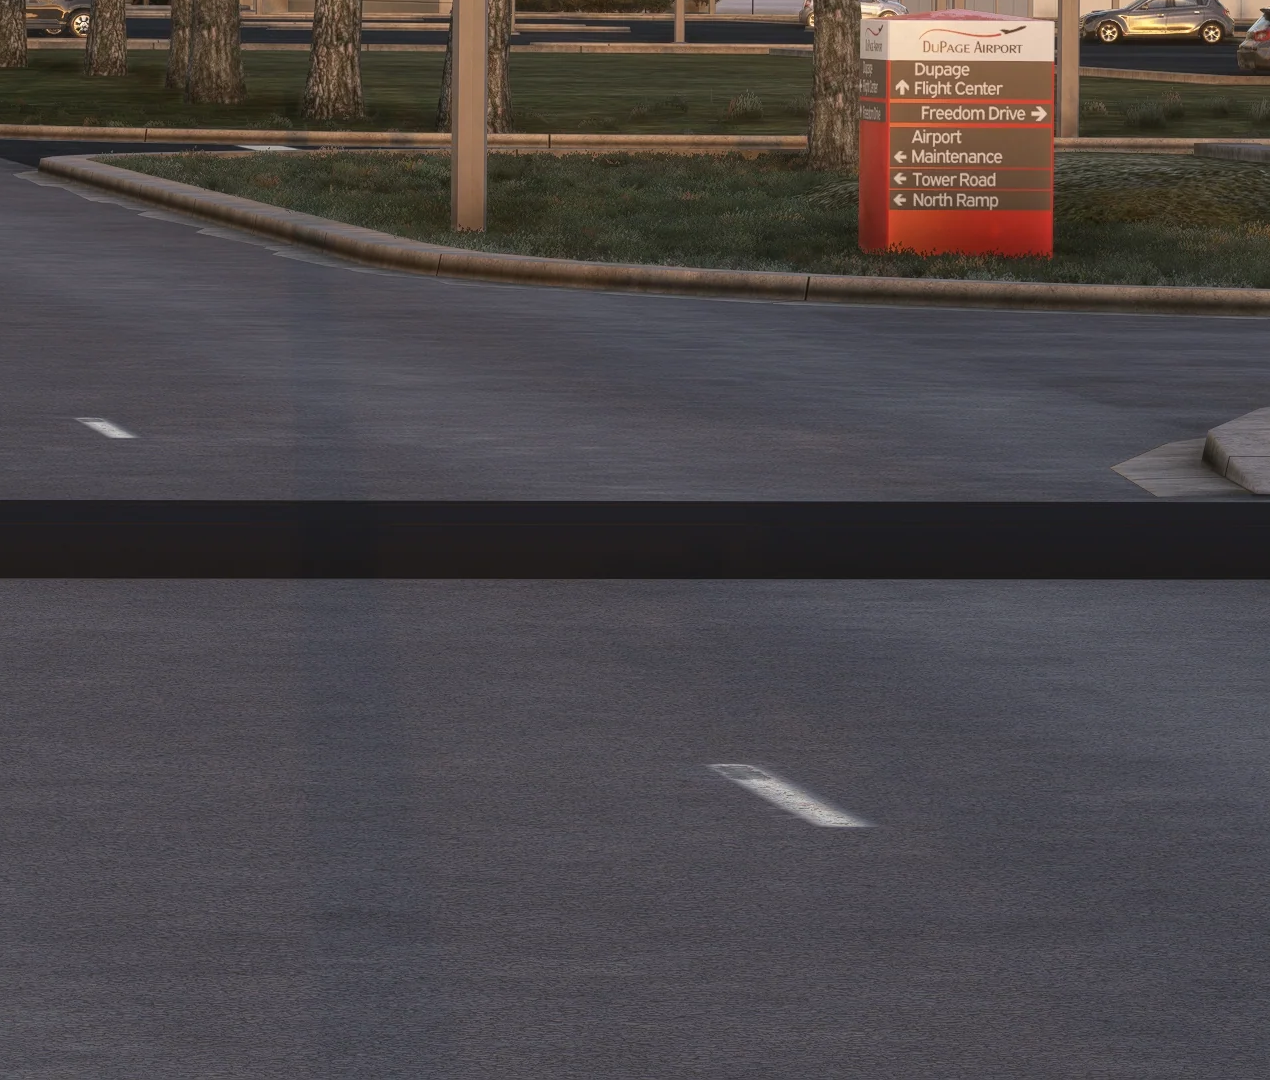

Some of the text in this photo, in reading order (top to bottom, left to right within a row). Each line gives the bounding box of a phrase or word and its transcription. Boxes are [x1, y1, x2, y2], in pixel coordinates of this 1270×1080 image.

[974, 41, 1023, 54] AIRPORT
[914, 62, 970, 79] Dupage
[914, 81, 1003, 98] Flight Center
[921, 105, 1026, 121] Freedom Drive
[911, 129, 962, 147] Airport
[912, 149, 1003, 164] Maintenance
[912, 172, 996, 187] Tower Road
[913, 193, 999, 210] North Ramp
